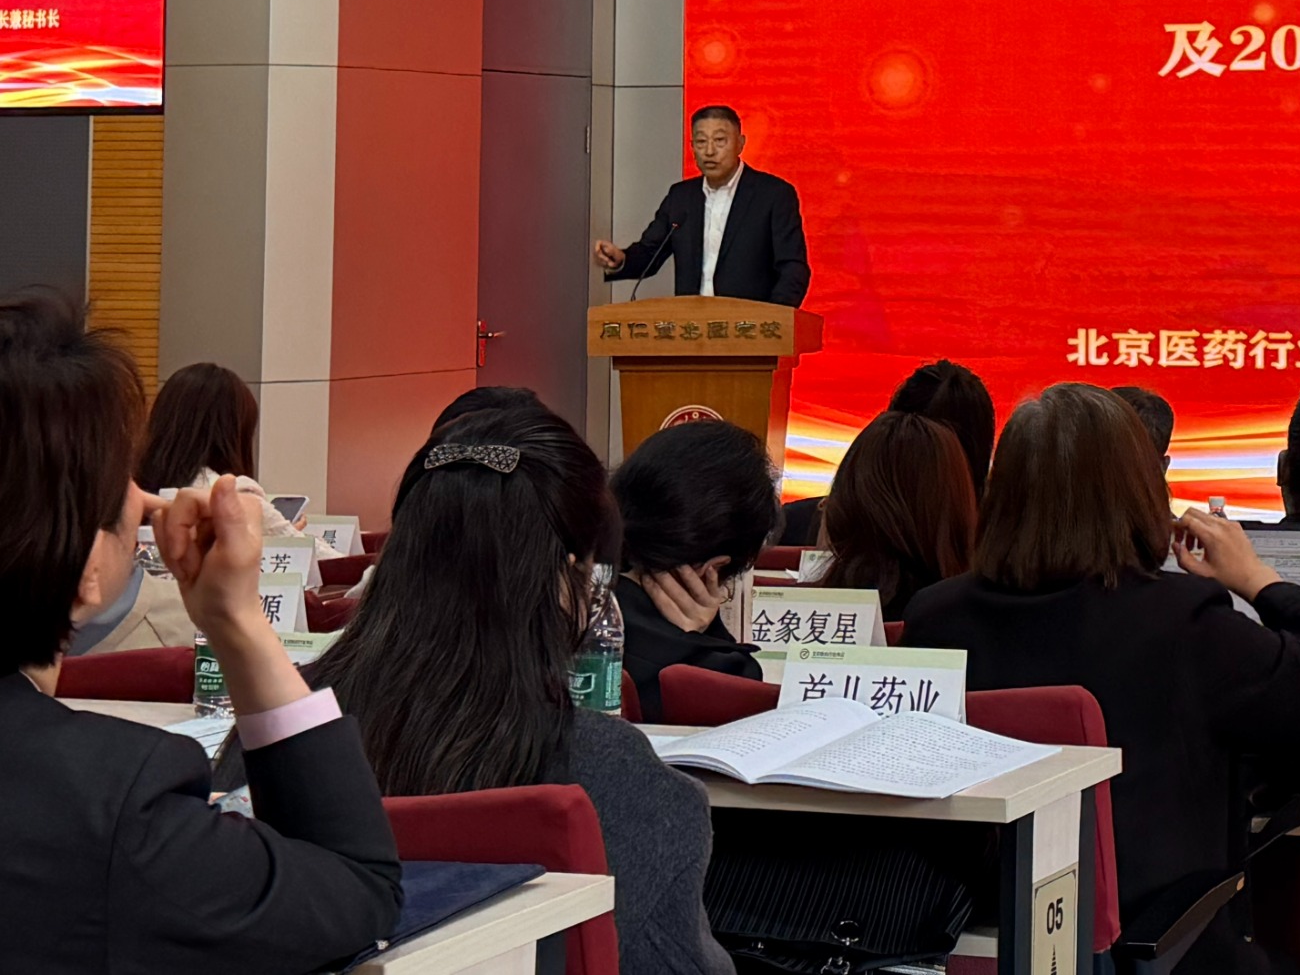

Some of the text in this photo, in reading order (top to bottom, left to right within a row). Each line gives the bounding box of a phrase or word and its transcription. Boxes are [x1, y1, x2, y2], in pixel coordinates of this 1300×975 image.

[752, 609, 858, 645] 金象复星
[1046, 896, 1064, 935] 05
